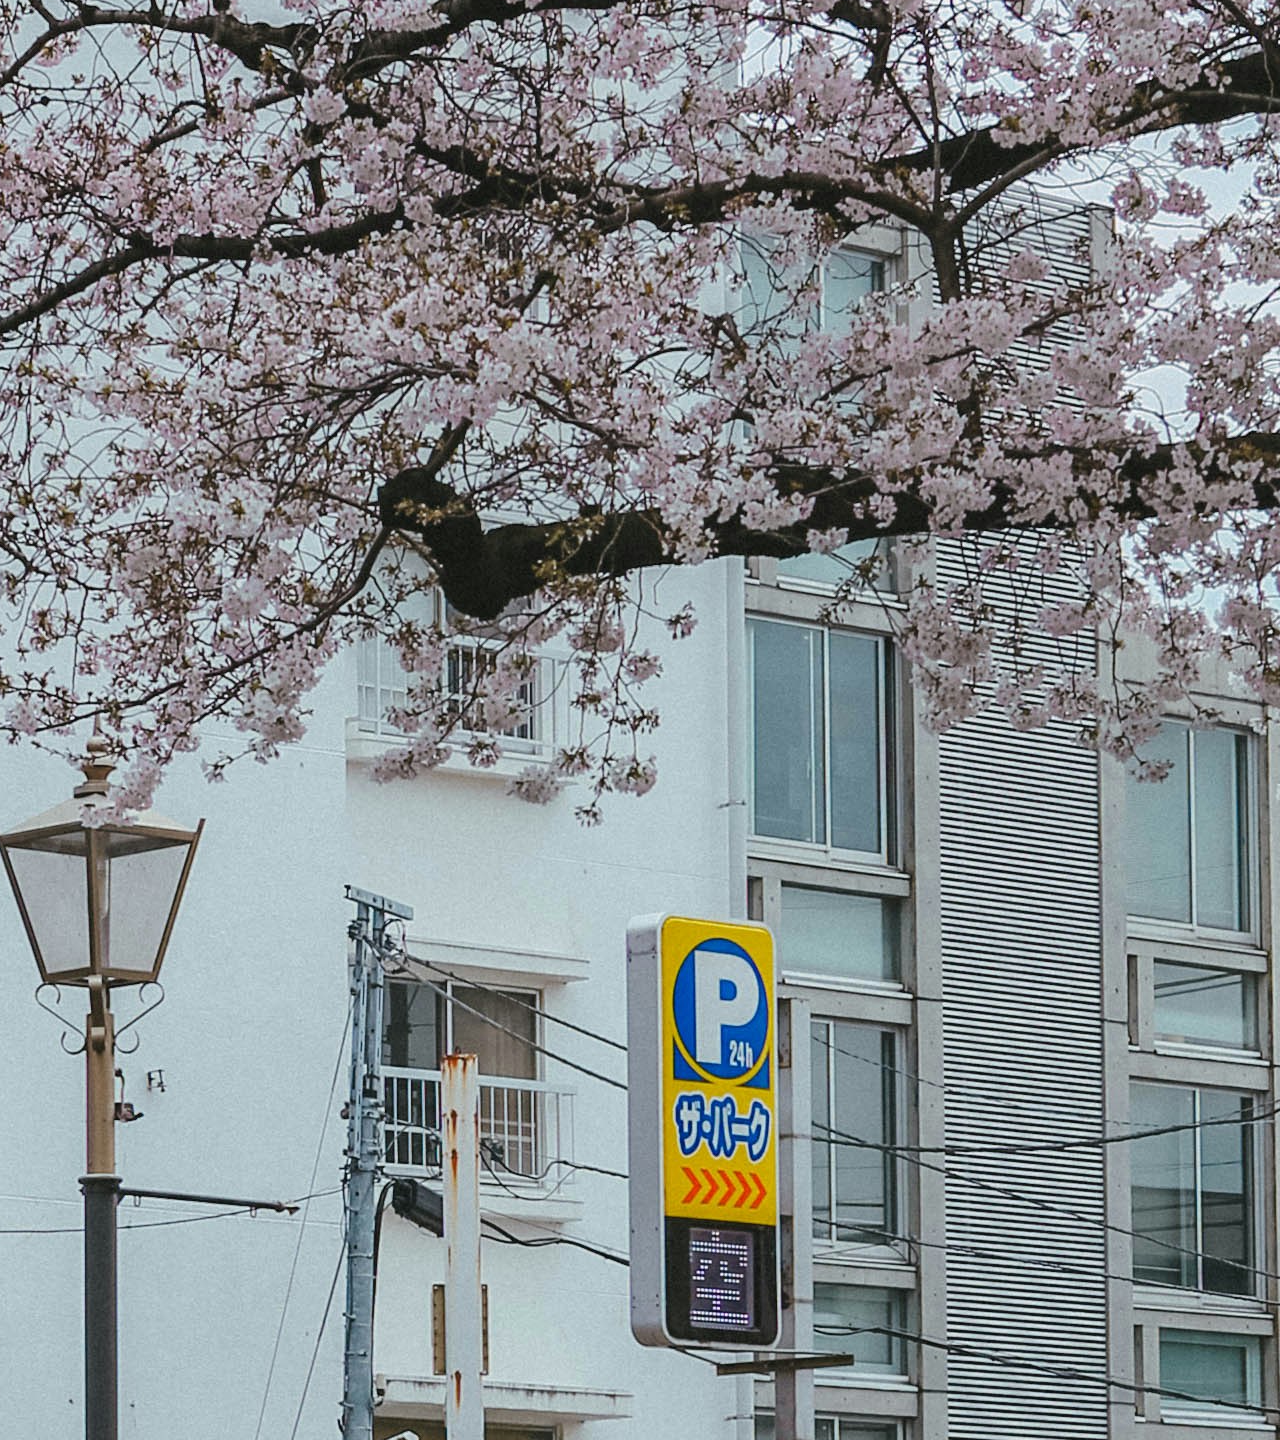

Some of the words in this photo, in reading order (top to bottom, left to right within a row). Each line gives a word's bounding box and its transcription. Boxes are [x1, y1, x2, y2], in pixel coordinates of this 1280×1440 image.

[694, 949, 760, 1065] P
[729, 1039, 754, 1069] 24h
[677, 1093, 769, 1160] ザ・パーク
[690, 1230, 748, 1325] 空
